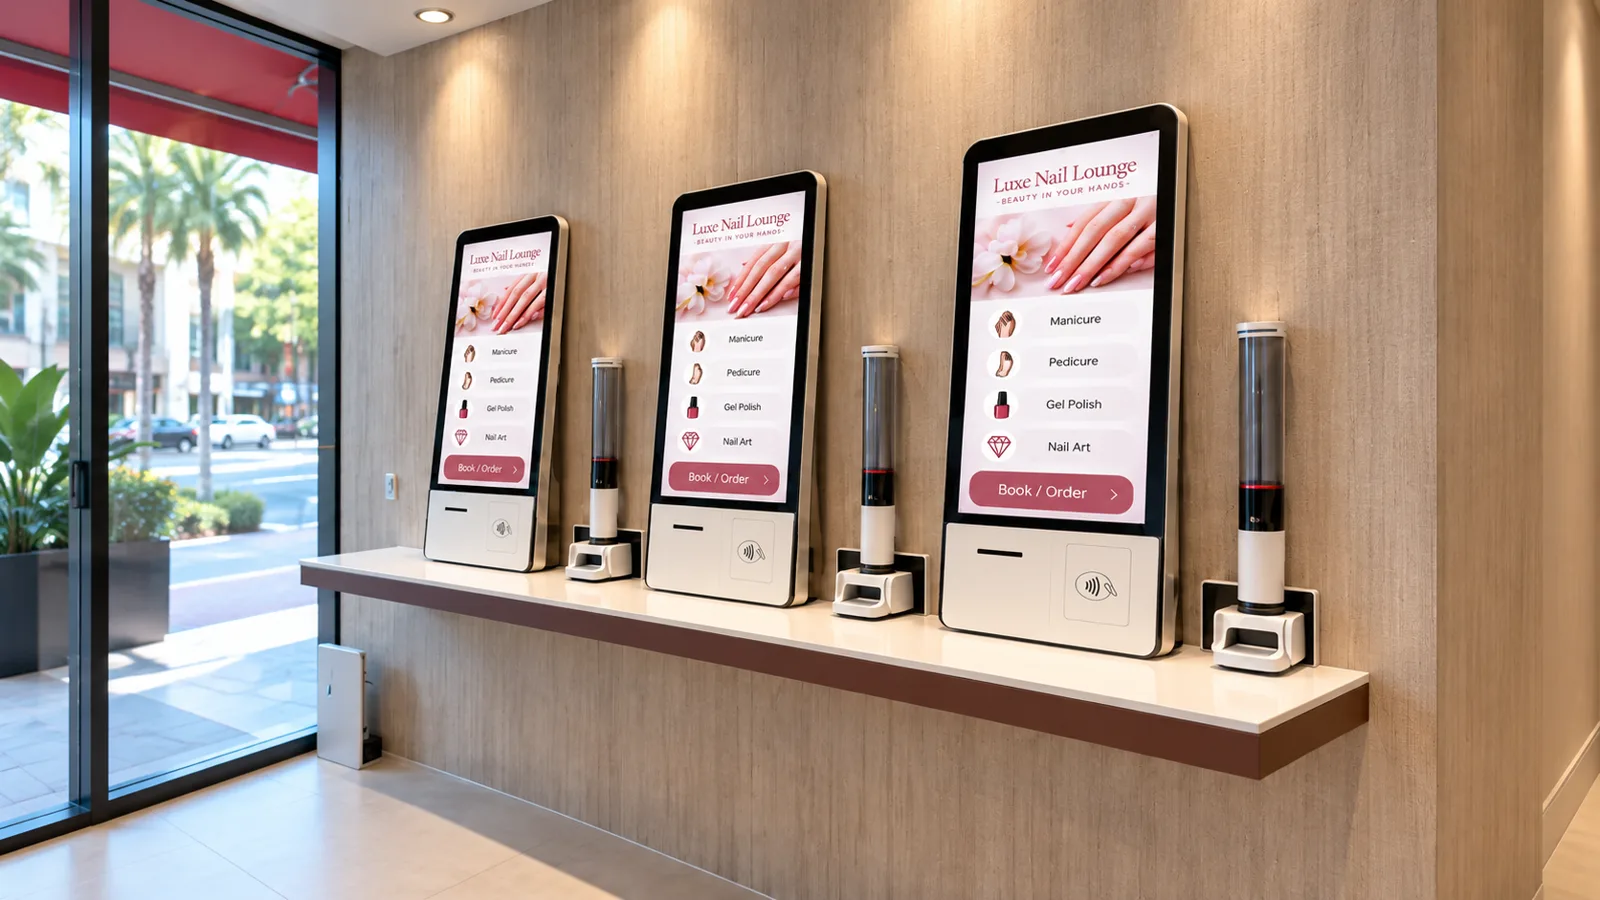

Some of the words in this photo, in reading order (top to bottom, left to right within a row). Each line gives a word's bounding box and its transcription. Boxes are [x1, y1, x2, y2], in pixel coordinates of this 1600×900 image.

[993, 178, 1031, 193] Luxe
[1034, 166, 1068, 187] Nail
[1072, 160, 1137, 181] Lounge
[1041, 191, 1052, 199] IN
[1056, 187, 1083, 196] YOUR
[692, 223, 719, 235] Luxe
[721, 215, 744, 231] Nail
[747, 212, 791, 227] Lounge
[470, 254, 489, 265] Luxe
[491, 249, 508, 262] Nail
[509, 249, 541, 261] Lounge
[1050, 315, 1102, 326] Manicure
[728, 335, 763, 343] Manicure
[1049, 357, 1099, 367] Pedicure
[726, 368, 760, 377] Pedicure
[490, 376, 515, 384] Pedicure
[724, 403, 737, 411] Gel
[738, 403, 761, 411] Polish
[1046, 399, 1065, 409] Gel
[1068, 399, 1102, 410] Polish
[723, 437, 738, 445] Nail
[739, 438, 752, 446] Art
[1048, 441, 1069, 452] Nail
[1072, 442, 1091, 452] Art
[458, 464, 475, 472] Book
[481, 464, 502, 473] Order
[688, 472, 711, 482] Book
[714, 473, 719, 483] /
[721, 473, 749, 484] Order
[998, 484, 1032, 497] Book
[1036, 485, 1042, 497] /
[1046, 486, 1087, 499] Order
